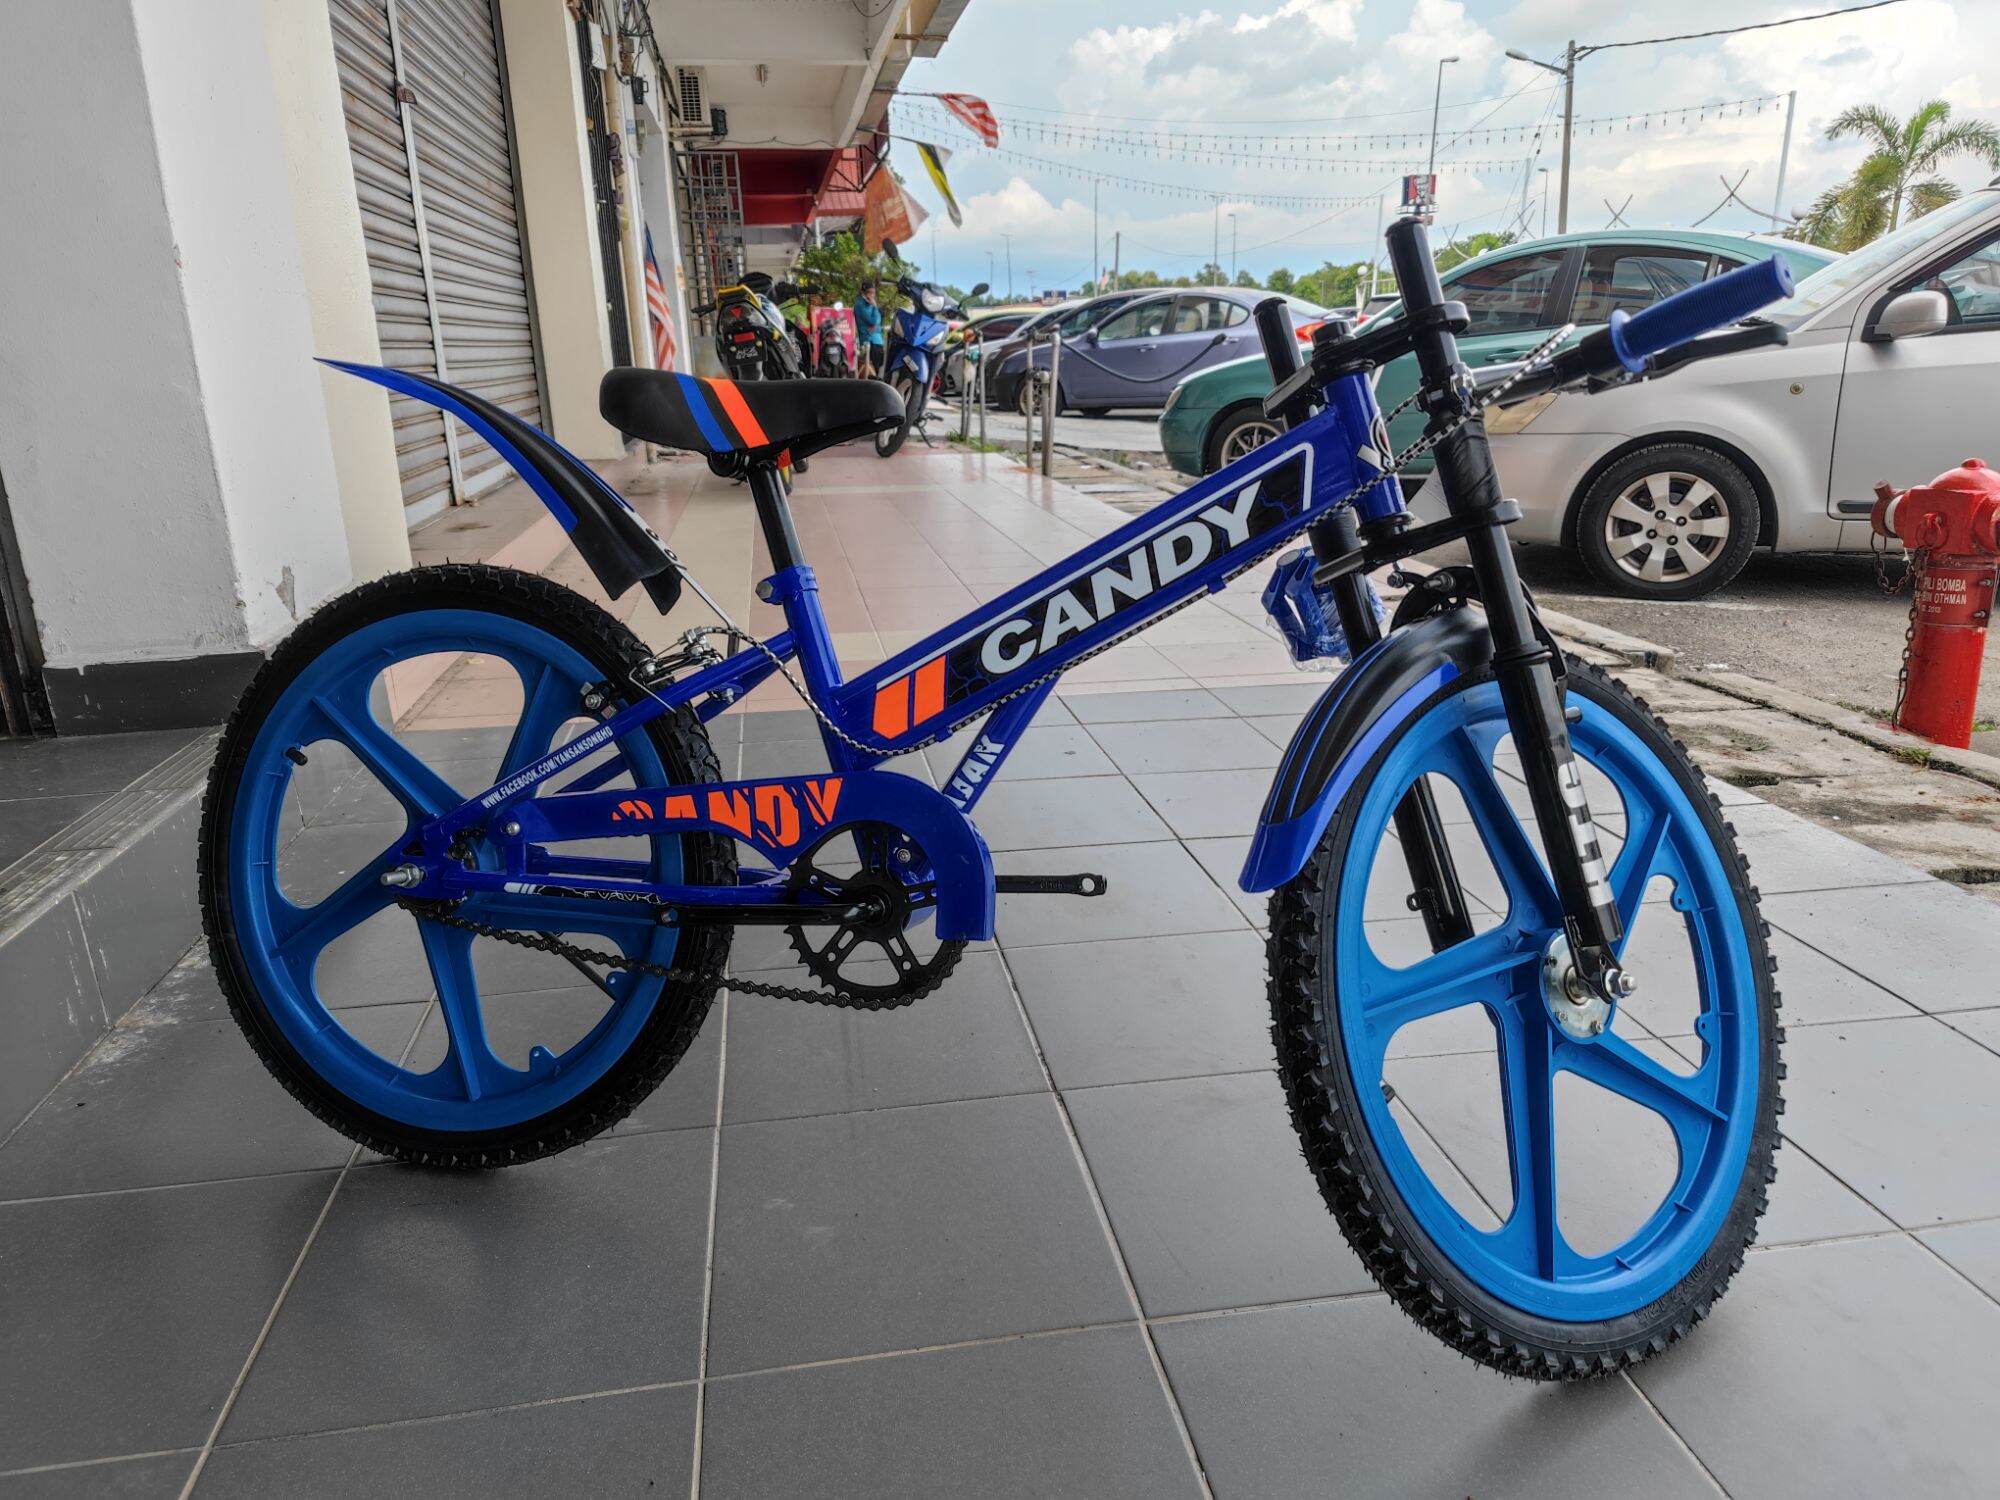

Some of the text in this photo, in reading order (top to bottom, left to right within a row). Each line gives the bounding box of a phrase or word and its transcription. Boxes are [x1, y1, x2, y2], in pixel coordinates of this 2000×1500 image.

[980, 479, 1263, 675] CANDY
[1936, 578, 1966, 592] BOMBA
[1934, 593, 1967, 605] OTHMAN
